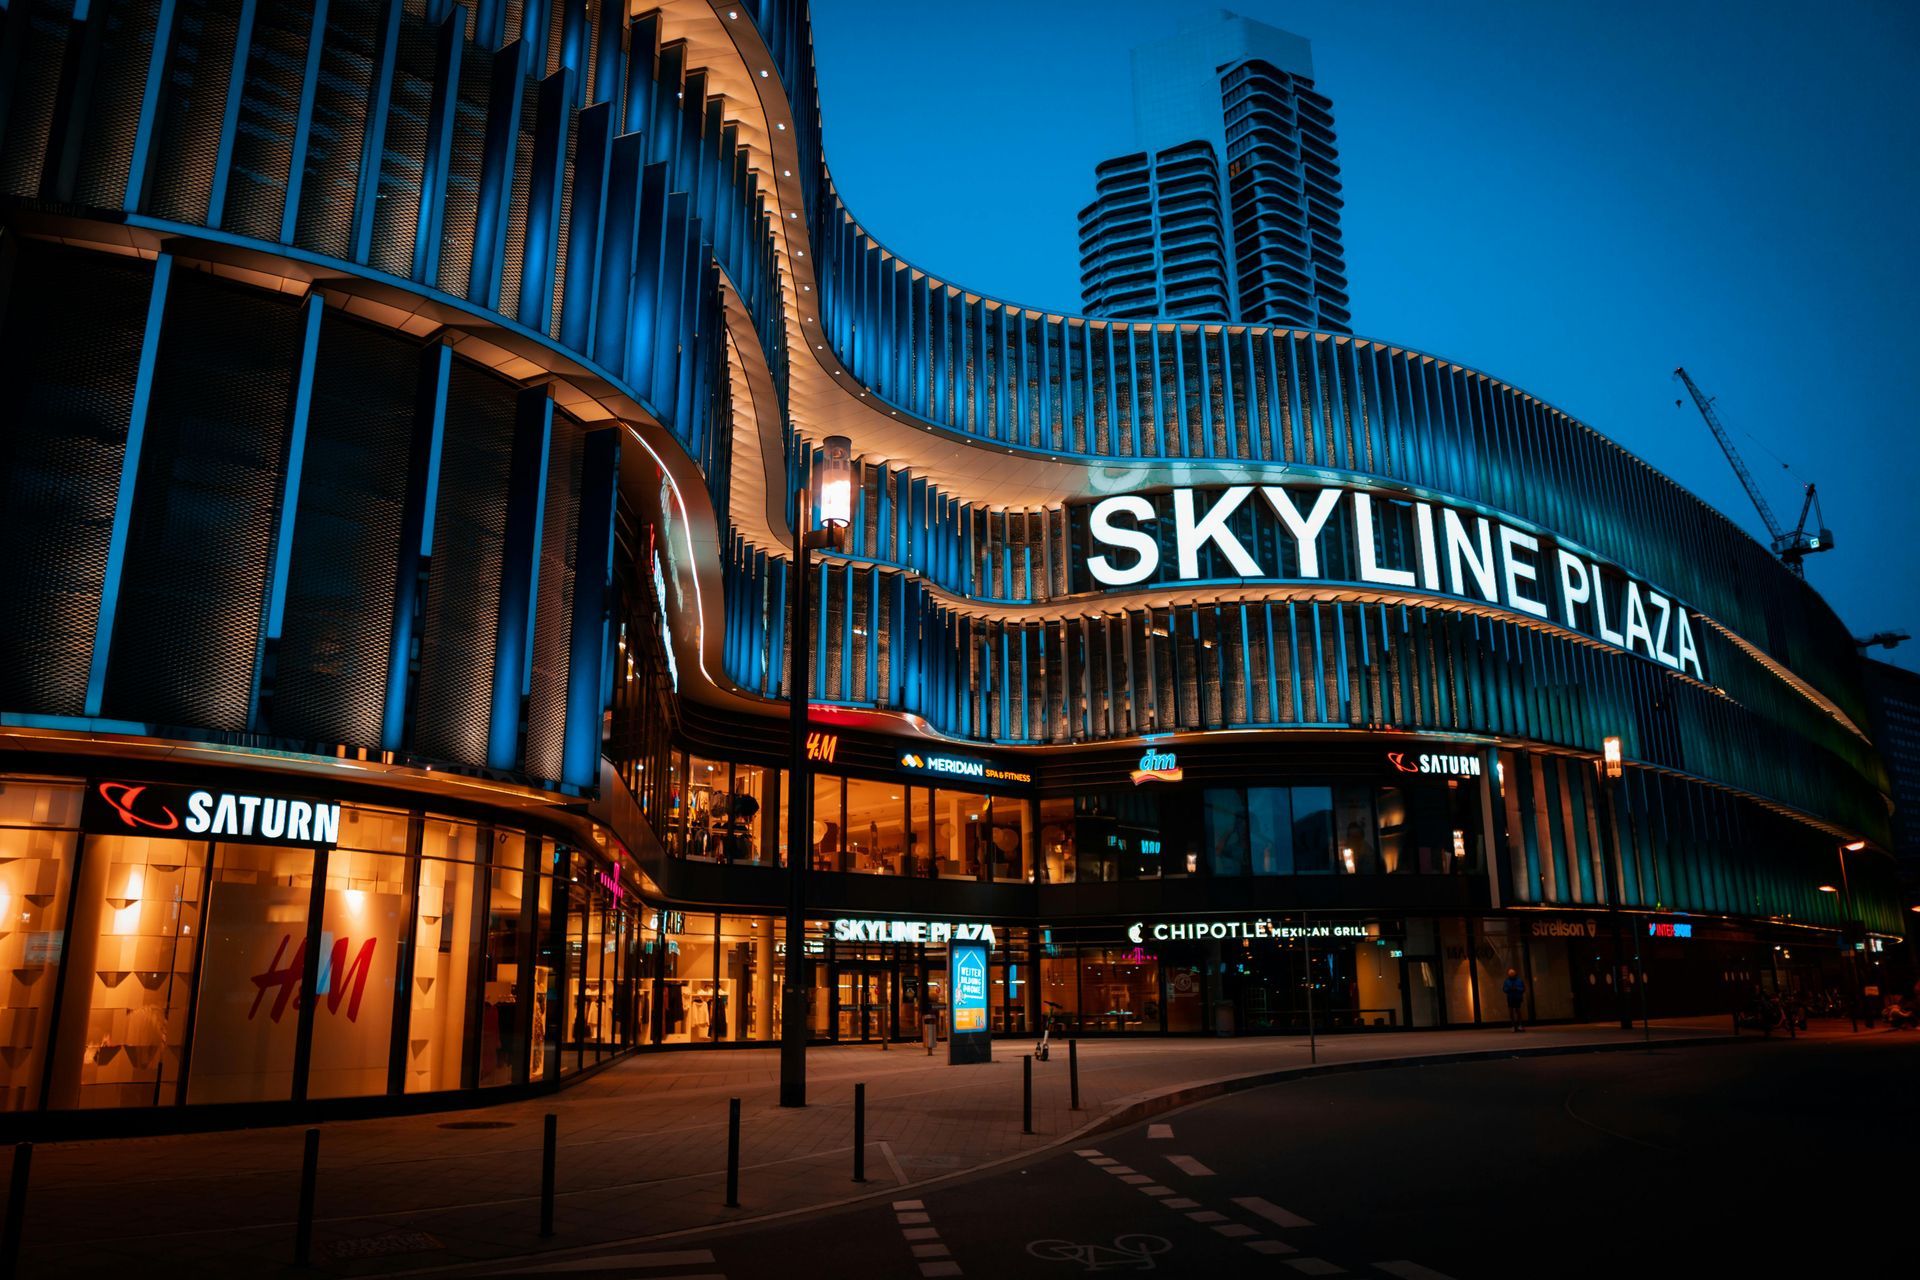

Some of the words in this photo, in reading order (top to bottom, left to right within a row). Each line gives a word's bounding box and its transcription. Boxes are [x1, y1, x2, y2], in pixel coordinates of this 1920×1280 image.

[1087, 486, 1548, 618] SKYLINE
[1557, 548, 1704, 680] PLAZA
[927, 756, 983, 777] MERIDIAN
[985, 769, 999, 778] SPA
[1004, 773, 1031, 783] FITNESS
[1139, 748, 1175, 771] dm
[1419, 754, 1480, 775] SATURN
[185, 791, 340, 843] SATURN
[835, 919, 927, 942] SKYLINE
[1153, 921, 1267, 940] CHIPOTLE
[1334, 926, 1369, 936] GRILL
[1531, 919, 1585, 937] strellson
